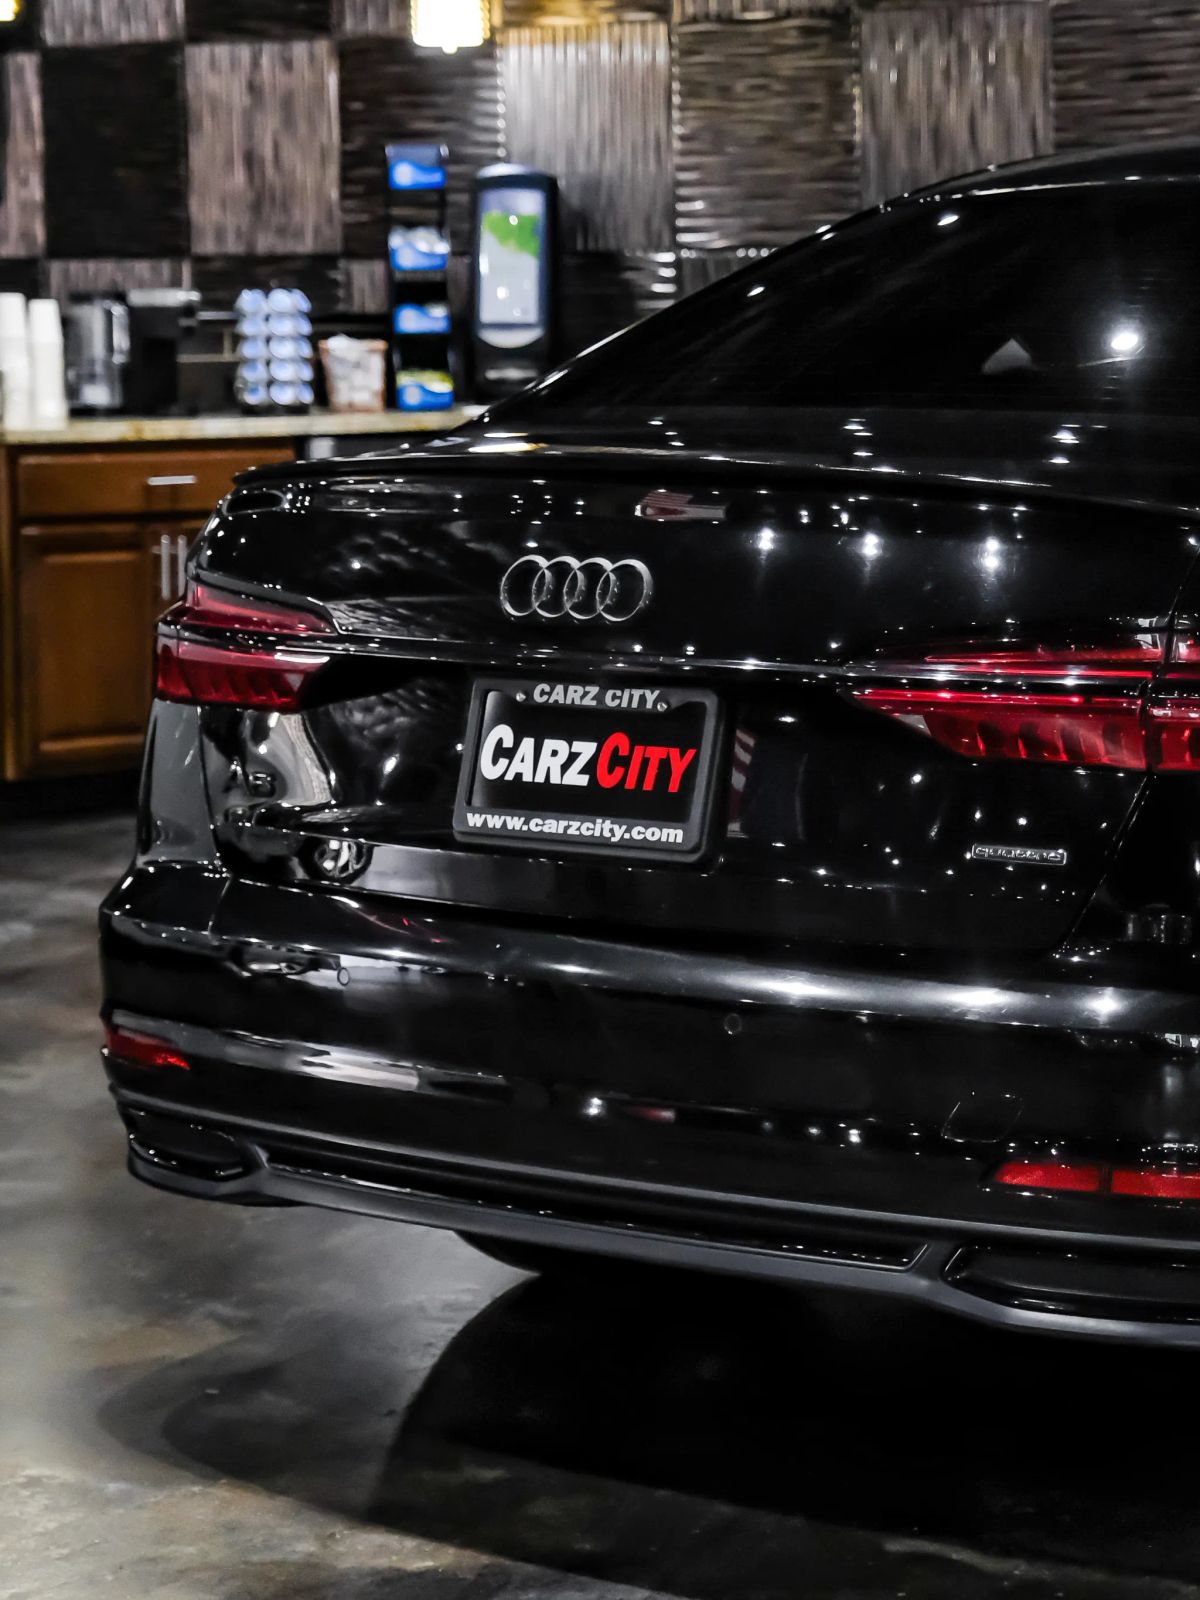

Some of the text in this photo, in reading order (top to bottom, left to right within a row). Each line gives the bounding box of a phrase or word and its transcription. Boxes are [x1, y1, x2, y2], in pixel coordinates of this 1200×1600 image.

[533, 683, 661, 709] CARZ CITY
[466, 812, 684, 843] www.carzcity.com
